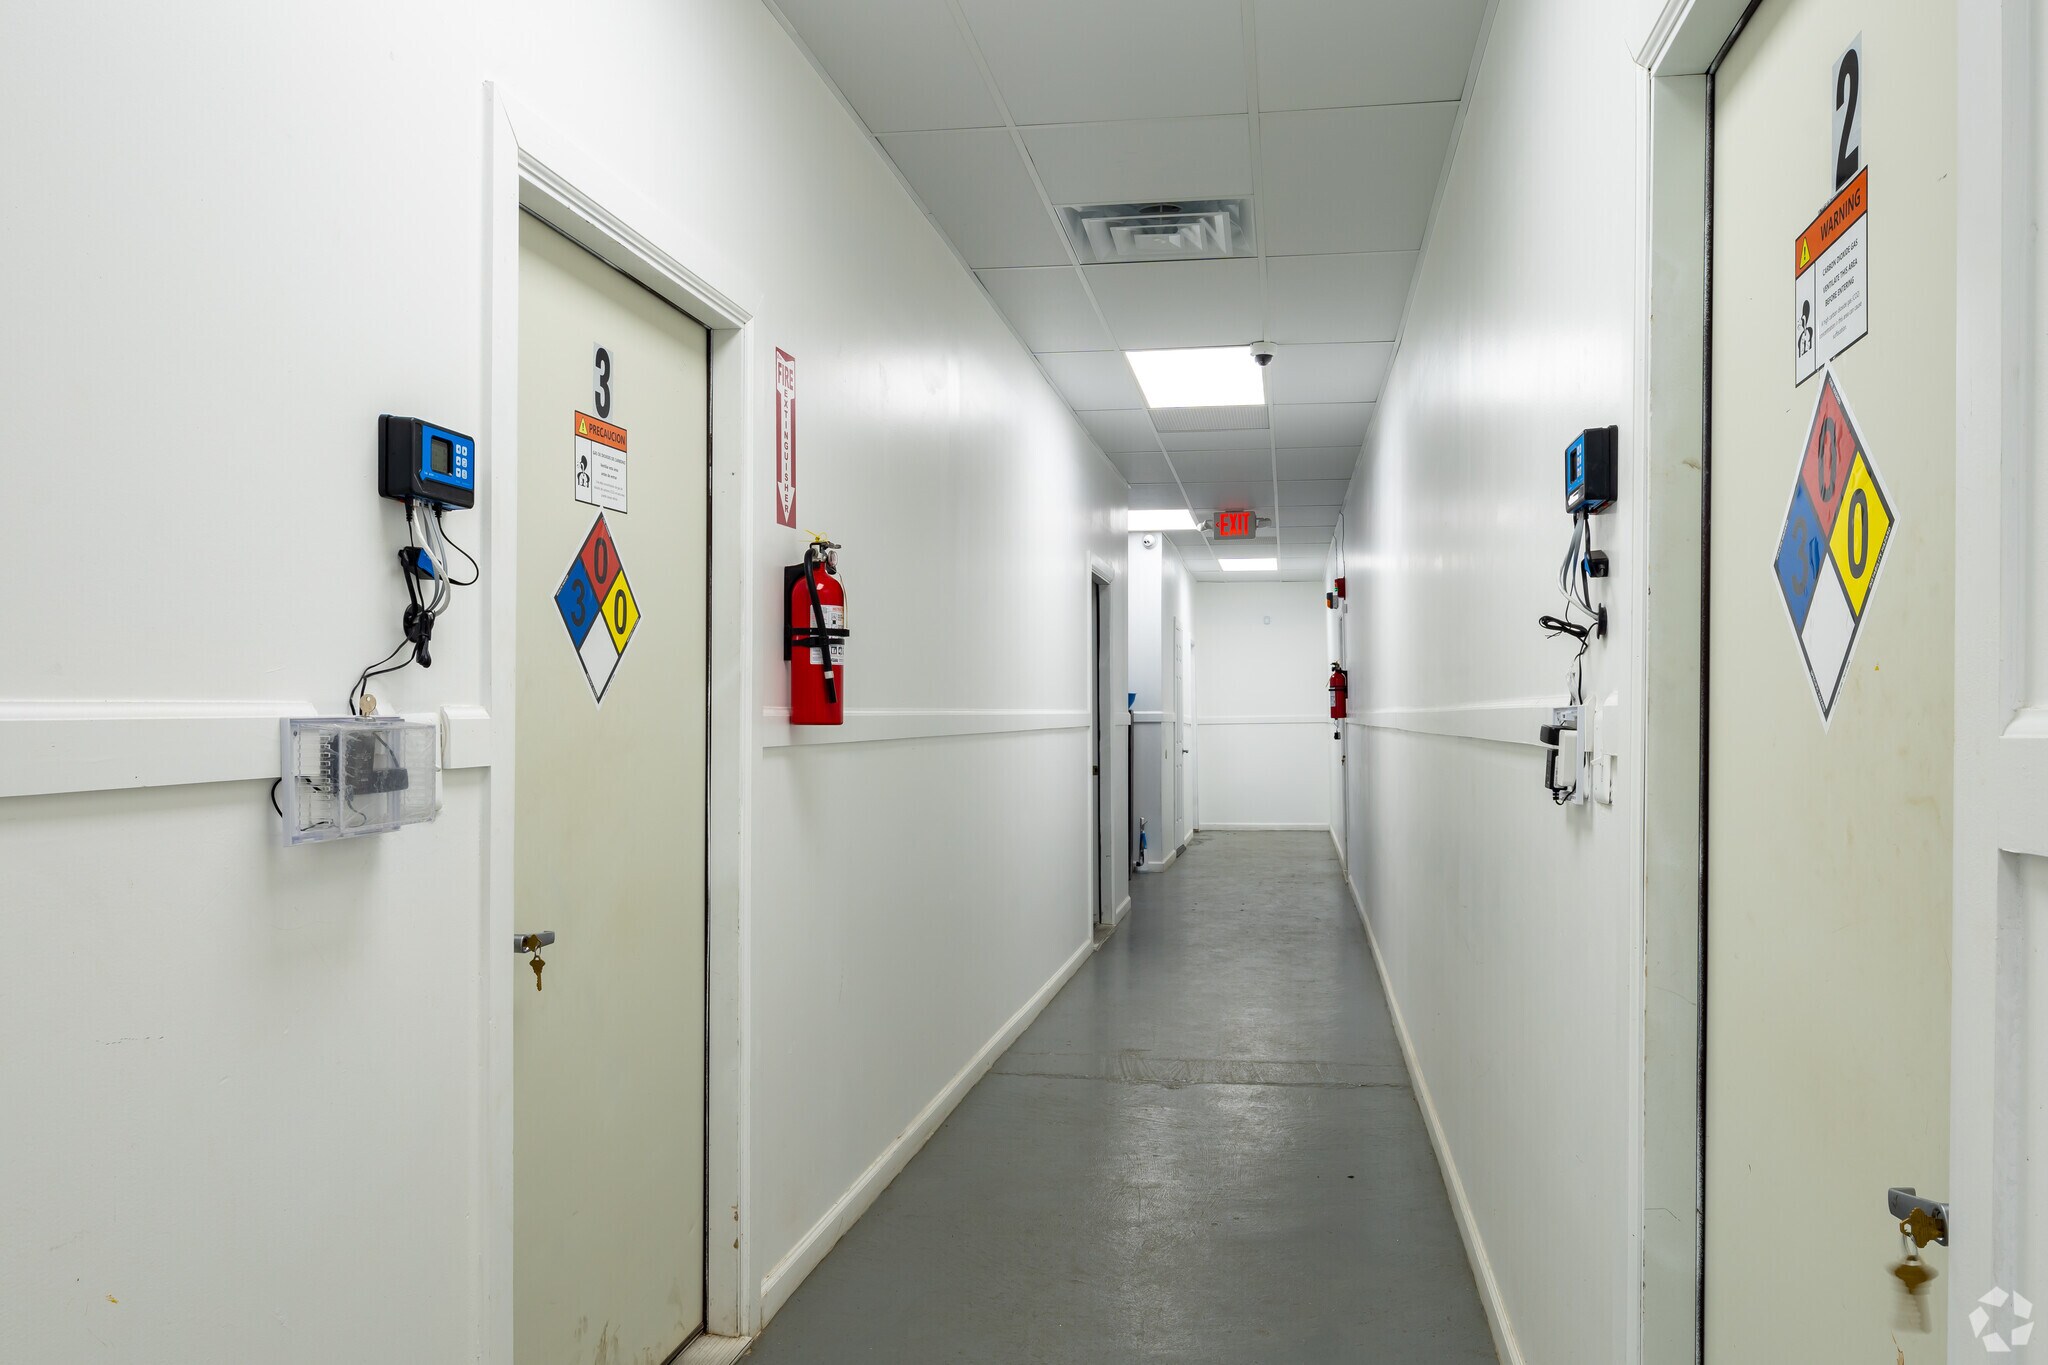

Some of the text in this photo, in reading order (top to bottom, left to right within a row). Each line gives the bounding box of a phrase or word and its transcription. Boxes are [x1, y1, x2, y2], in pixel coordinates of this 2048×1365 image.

[1836, 48, 1859, 192] 2
[1820, 188, 1860, 242] WARNING
[1822, 258, 1837, 277] CARBON
[1849, 258, 1858, 270] AREA
[595, 348, 610, 419] 3
[778, 361, 794, 391] FIRE
[589, 423, 626, 445] PRECAUCION
[1818, 417, 1837, 503] 0
[1220, 512, 1250, 537] EXIT
[1847, 488, 1869, 579] 0
[594, 537, 608, 585] 0
[1792, 518, 1808, 596] 3
[571, 578, 586, 627] 3
[614, 588, 627, 635] 0
